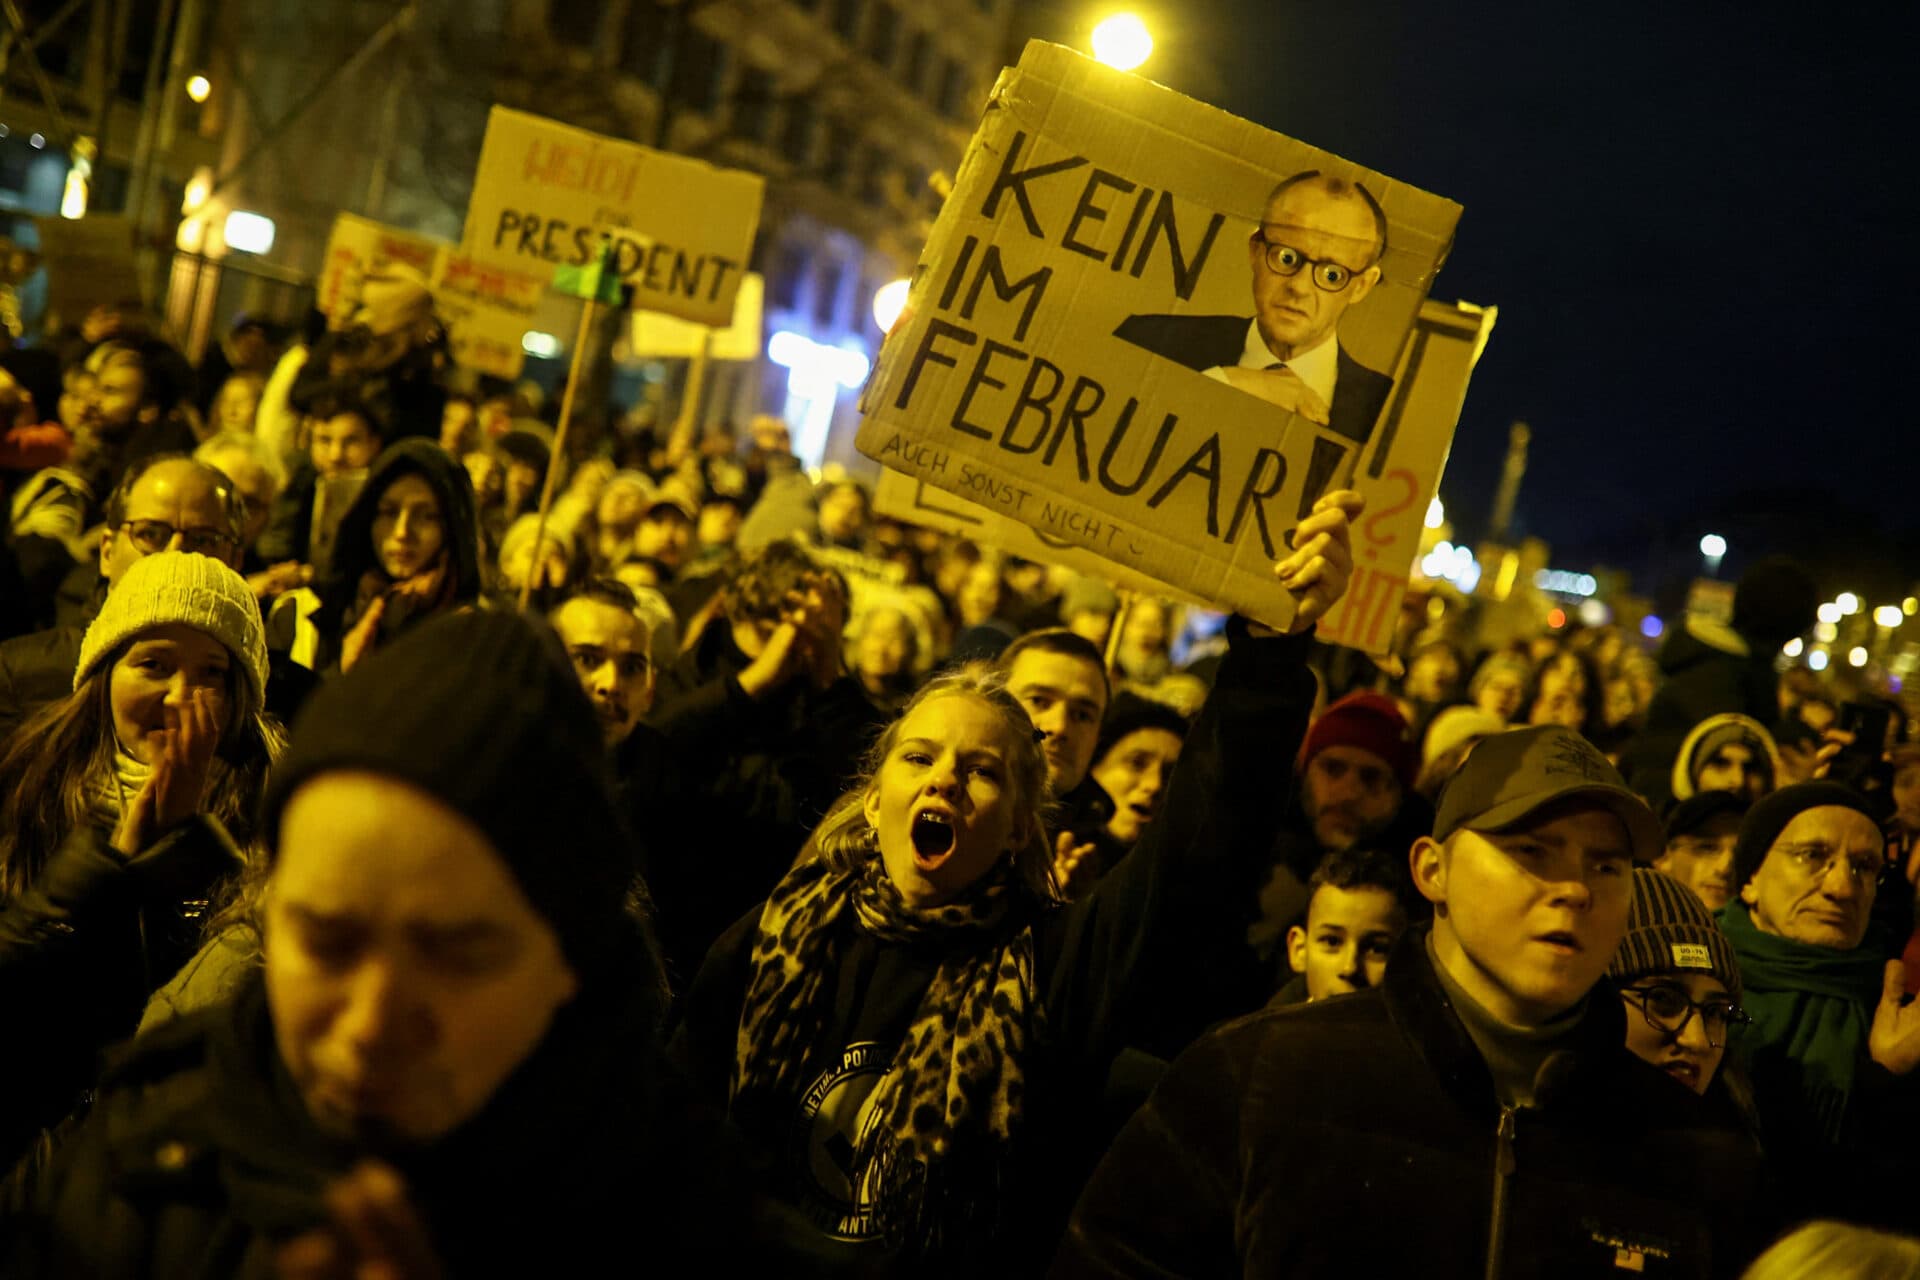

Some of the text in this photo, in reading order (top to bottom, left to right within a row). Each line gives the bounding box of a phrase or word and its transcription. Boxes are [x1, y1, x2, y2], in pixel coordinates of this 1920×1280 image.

[981, 130, 1226, 301] KEIN
[938, 236, 1053, 342] IM
[880, 433, 949, 474] AUCH
[958, 463, 1032, 512] SONST
[1041, 504, 1123, 552] NICHT
[894, 318, 1348, 561] FEBRUAR!
